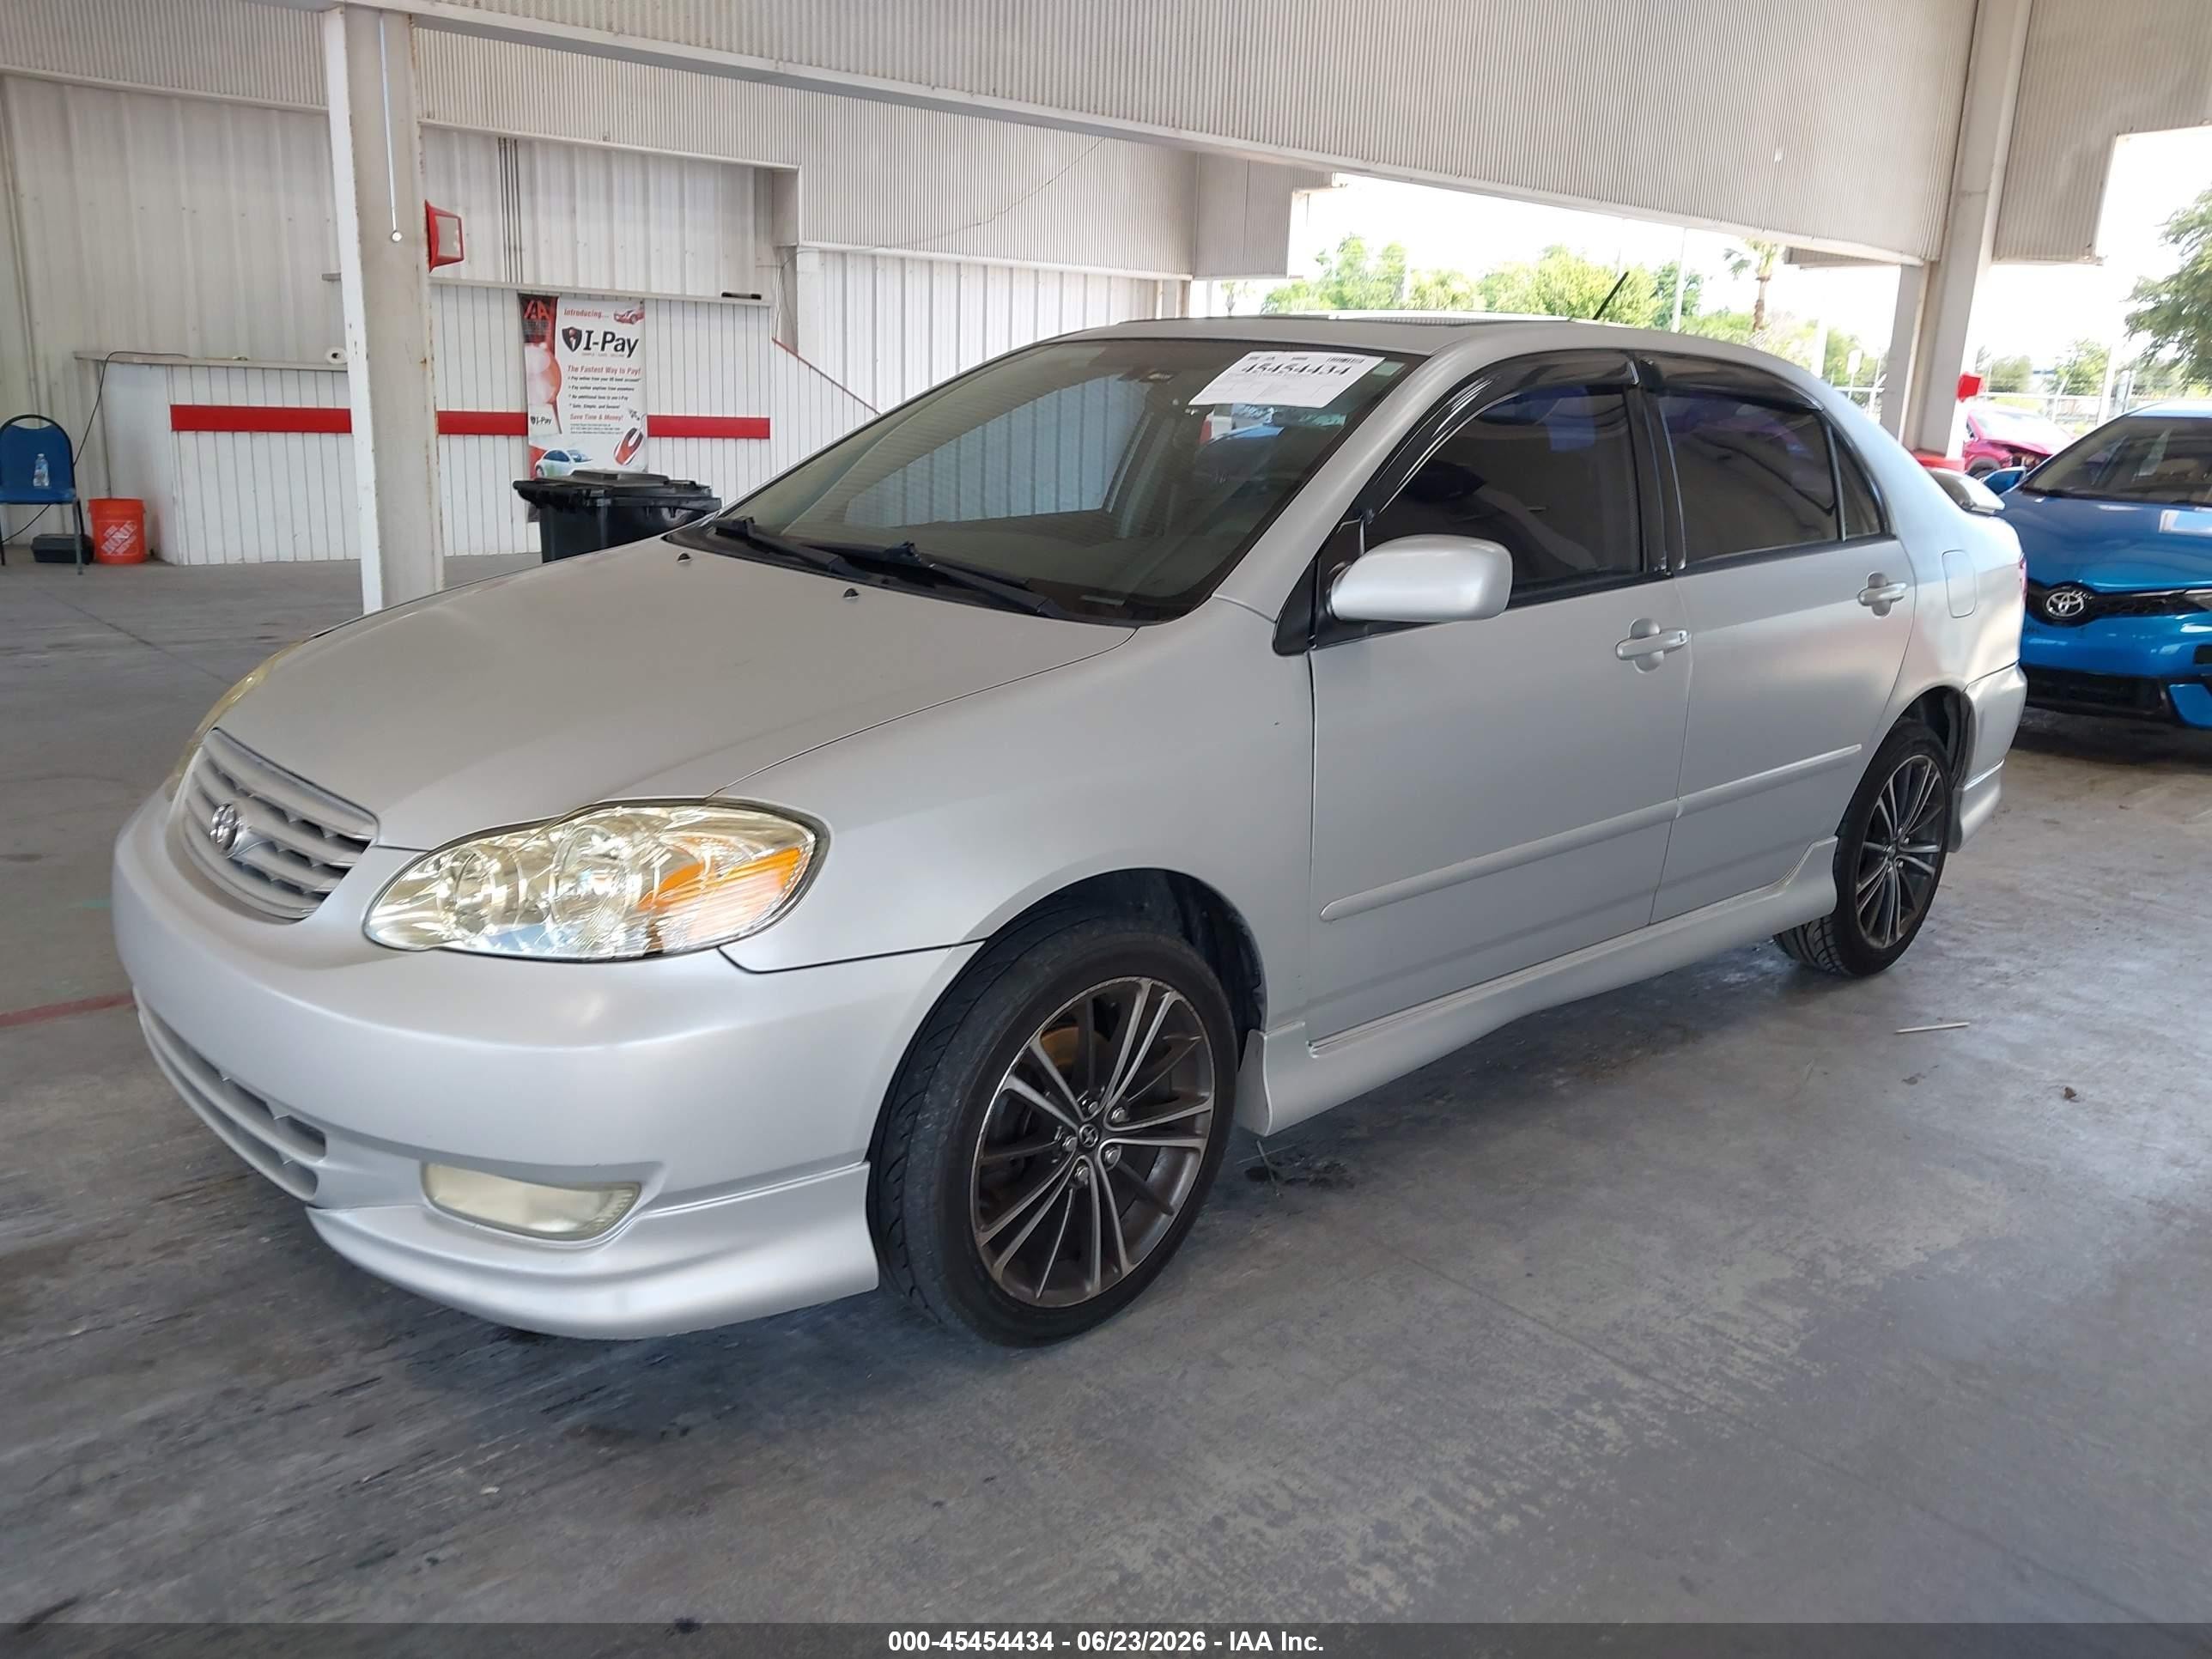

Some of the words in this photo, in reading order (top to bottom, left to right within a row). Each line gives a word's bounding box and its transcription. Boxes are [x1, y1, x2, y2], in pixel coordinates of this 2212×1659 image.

[583, 330, 639, 358] I-Pay
[568, 364, 579, 373] The
[580, 365, 604, 374] Fastest
[605, 366, 618, 375] Way
[627, 367, 641, 376] Pay!
